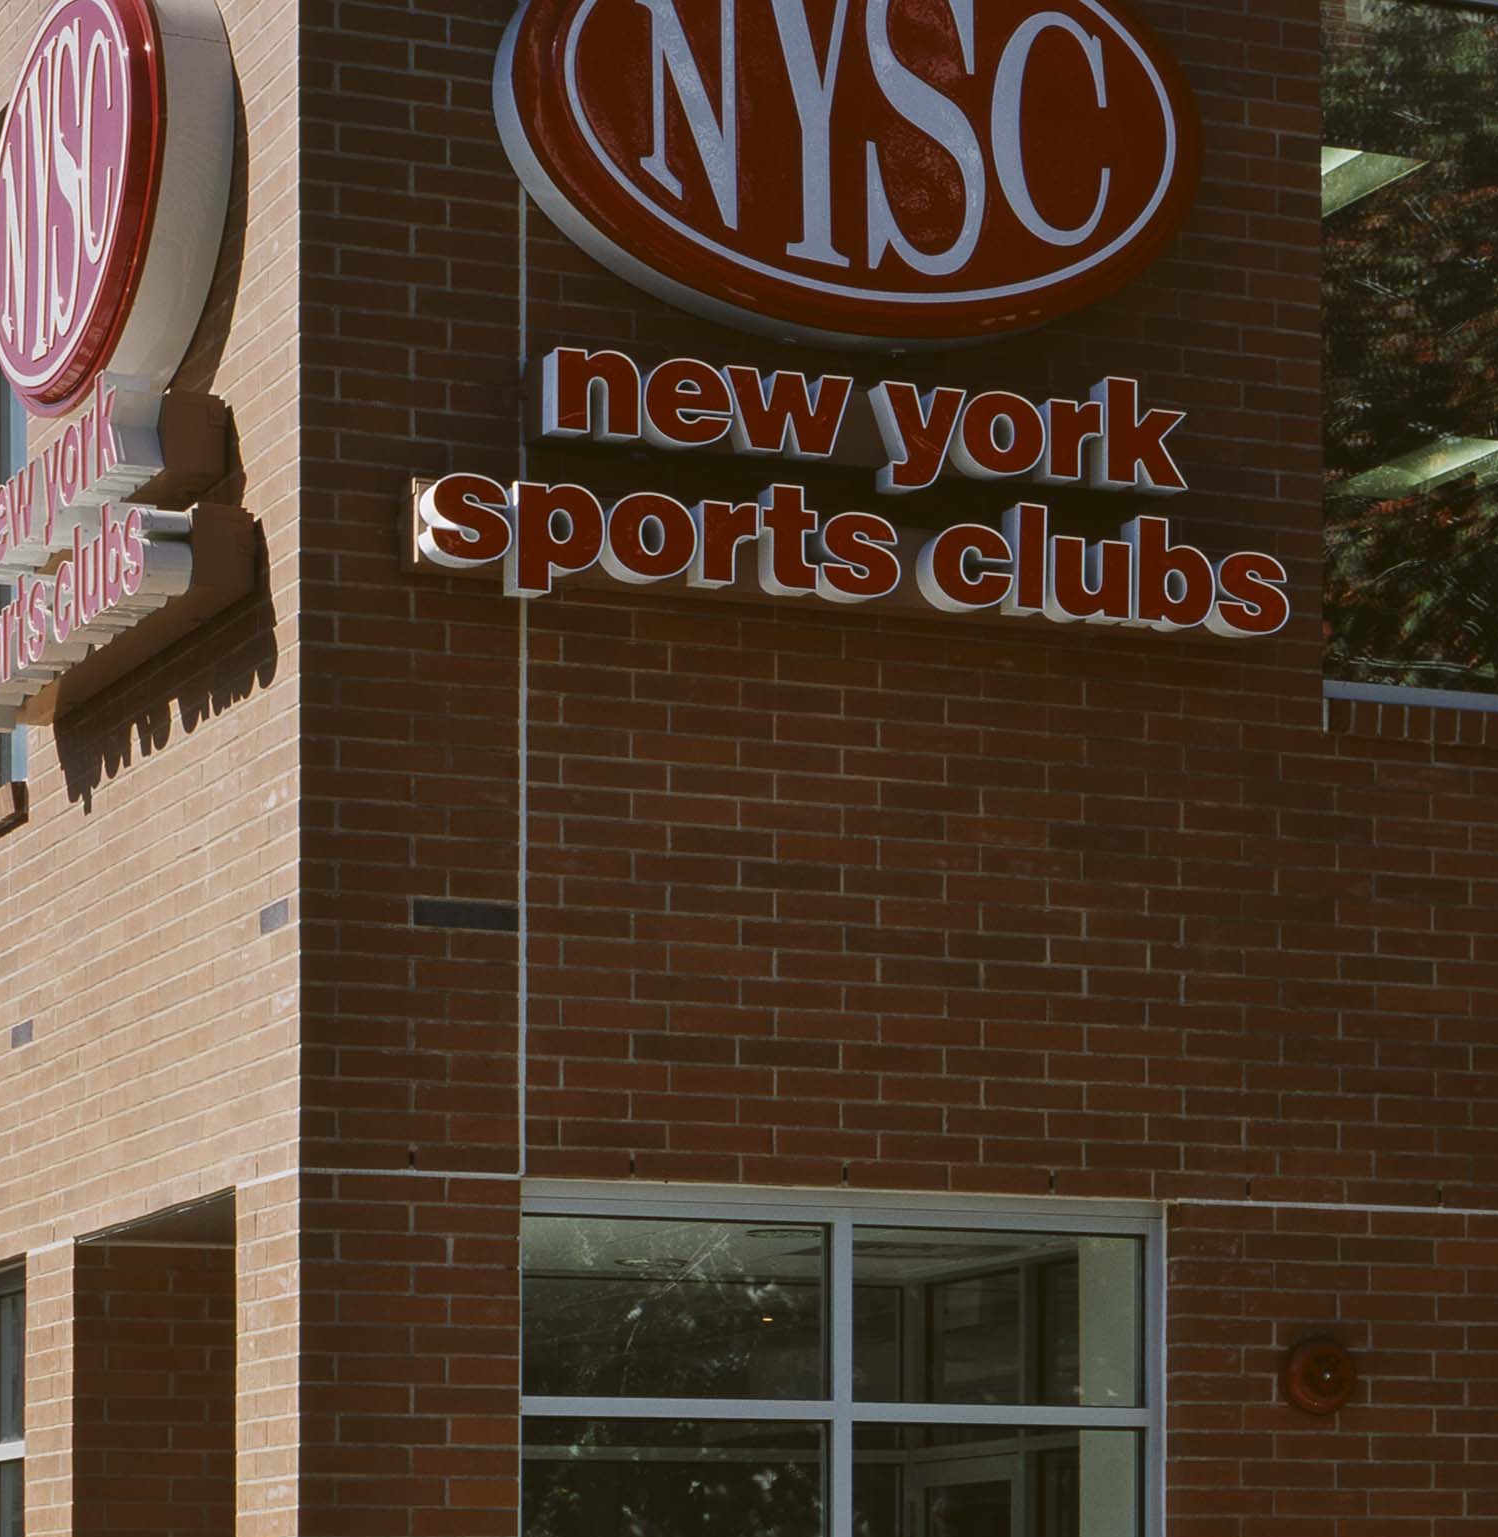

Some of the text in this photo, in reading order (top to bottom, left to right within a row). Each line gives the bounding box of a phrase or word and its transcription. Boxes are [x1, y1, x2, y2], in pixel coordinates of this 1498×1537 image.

[0, 24, 114, 362] NYSC
[42, 368, 119, 548] york
[542, 345, 1189, 495] new york
[53, 499, 145, 645] clubs
[418, 472, 1289, 638] sports clubs
